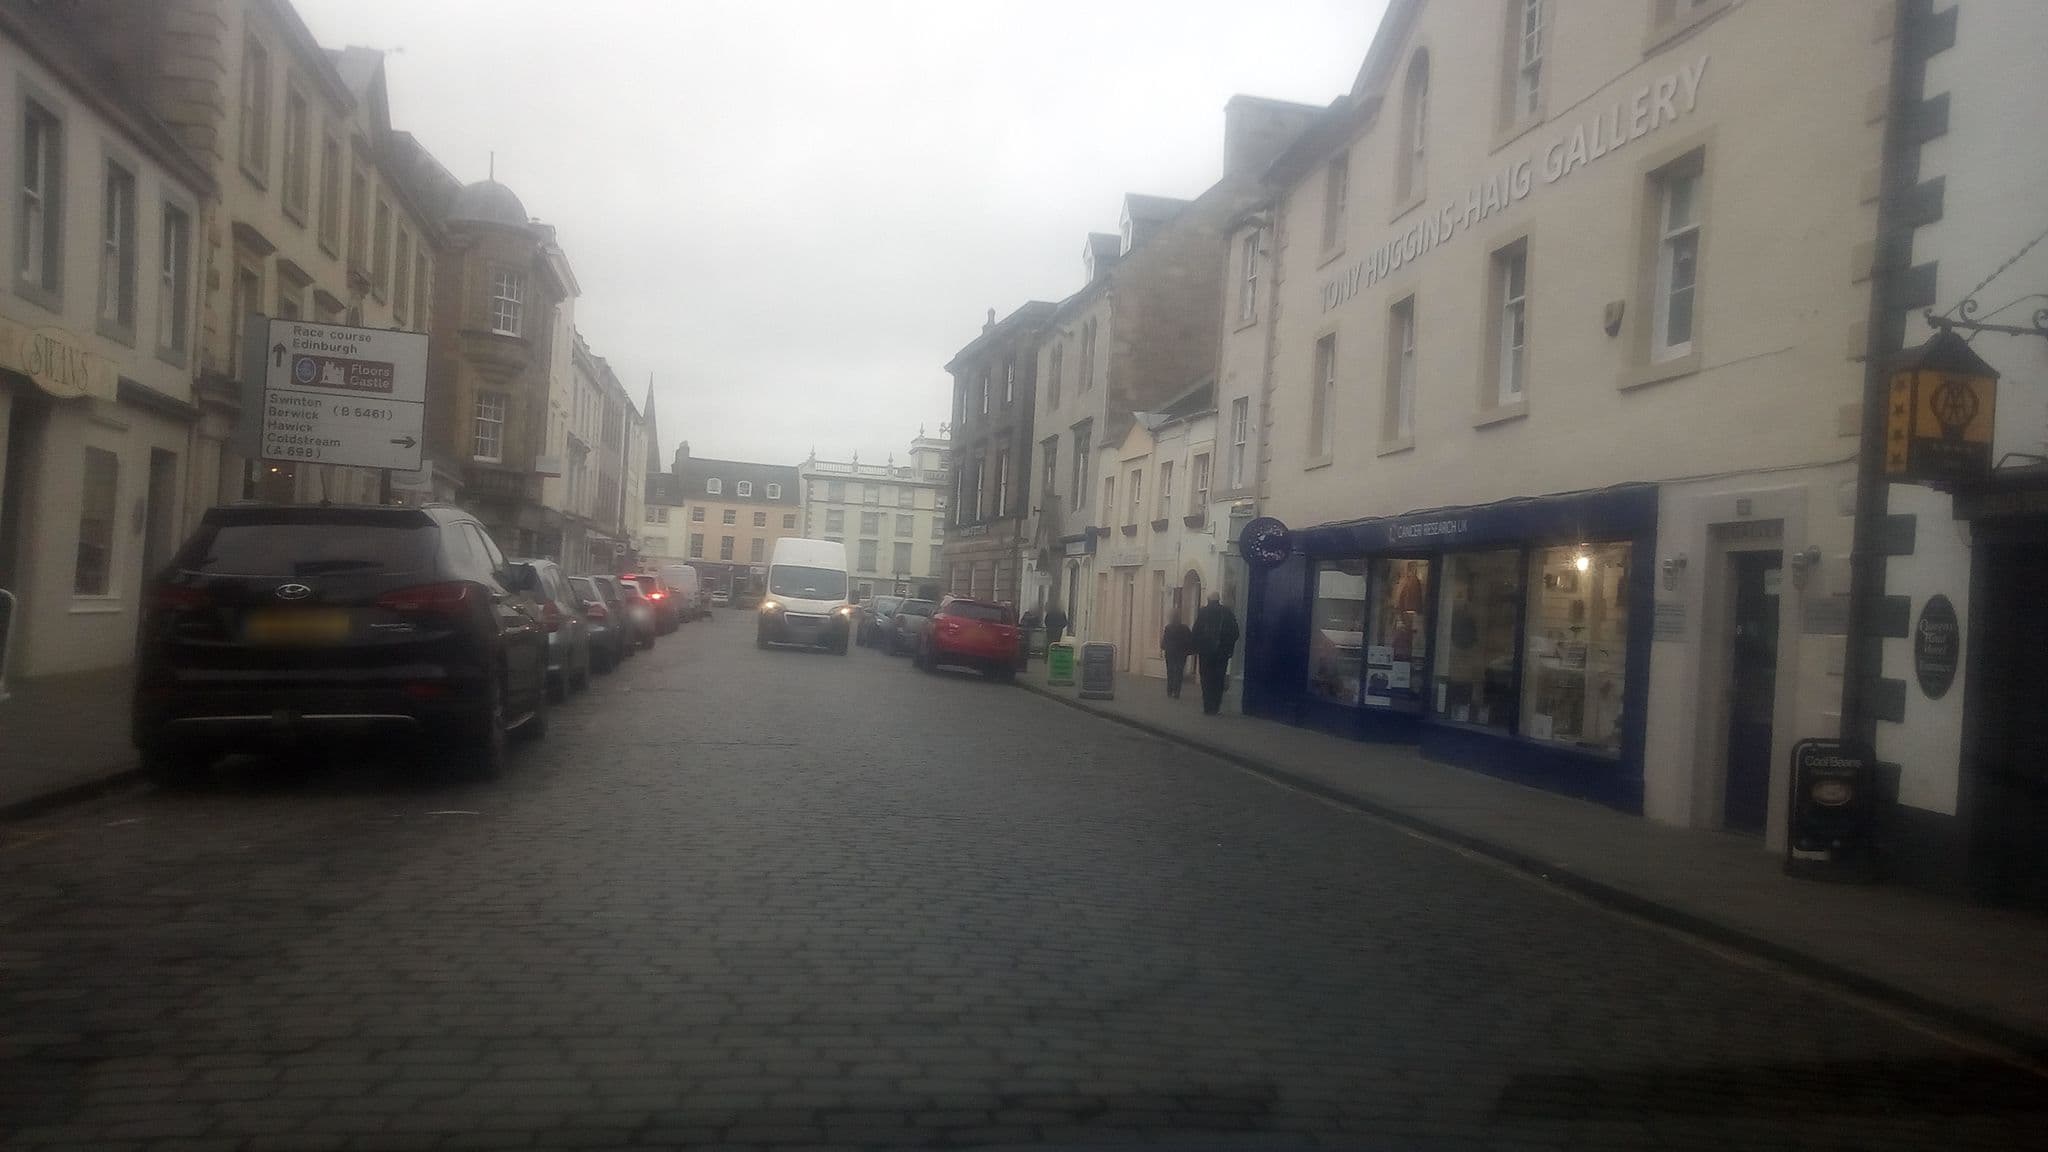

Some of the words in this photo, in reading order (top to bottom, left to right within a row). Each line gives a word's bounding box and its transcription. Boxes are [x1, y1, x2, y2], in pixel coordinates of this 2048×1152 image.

[1320, 261, 1363, 314] TONY
[1365, 157, 1533, 289] HUGGINS-HAIG
[1545, 55, 1711, 184] GALLERY
[293, 325, 324, 338] Race
[329, 331, 372, 343] course
[292, 338, 358, 355] Edinburgh
[351, 363, 391, 377] Floors
[350, 375, 390, 389] Castle
[270, 393, 322, 407] Swinton
[268, 406, 320, 420] Berwick
[267, 419, 313, 432] Hawick
[267, 432, 341, 447] Coldstream
[1398, 523, 1422, 539] CANCER
[1423, 520, 1457, 536] RESEARCH
